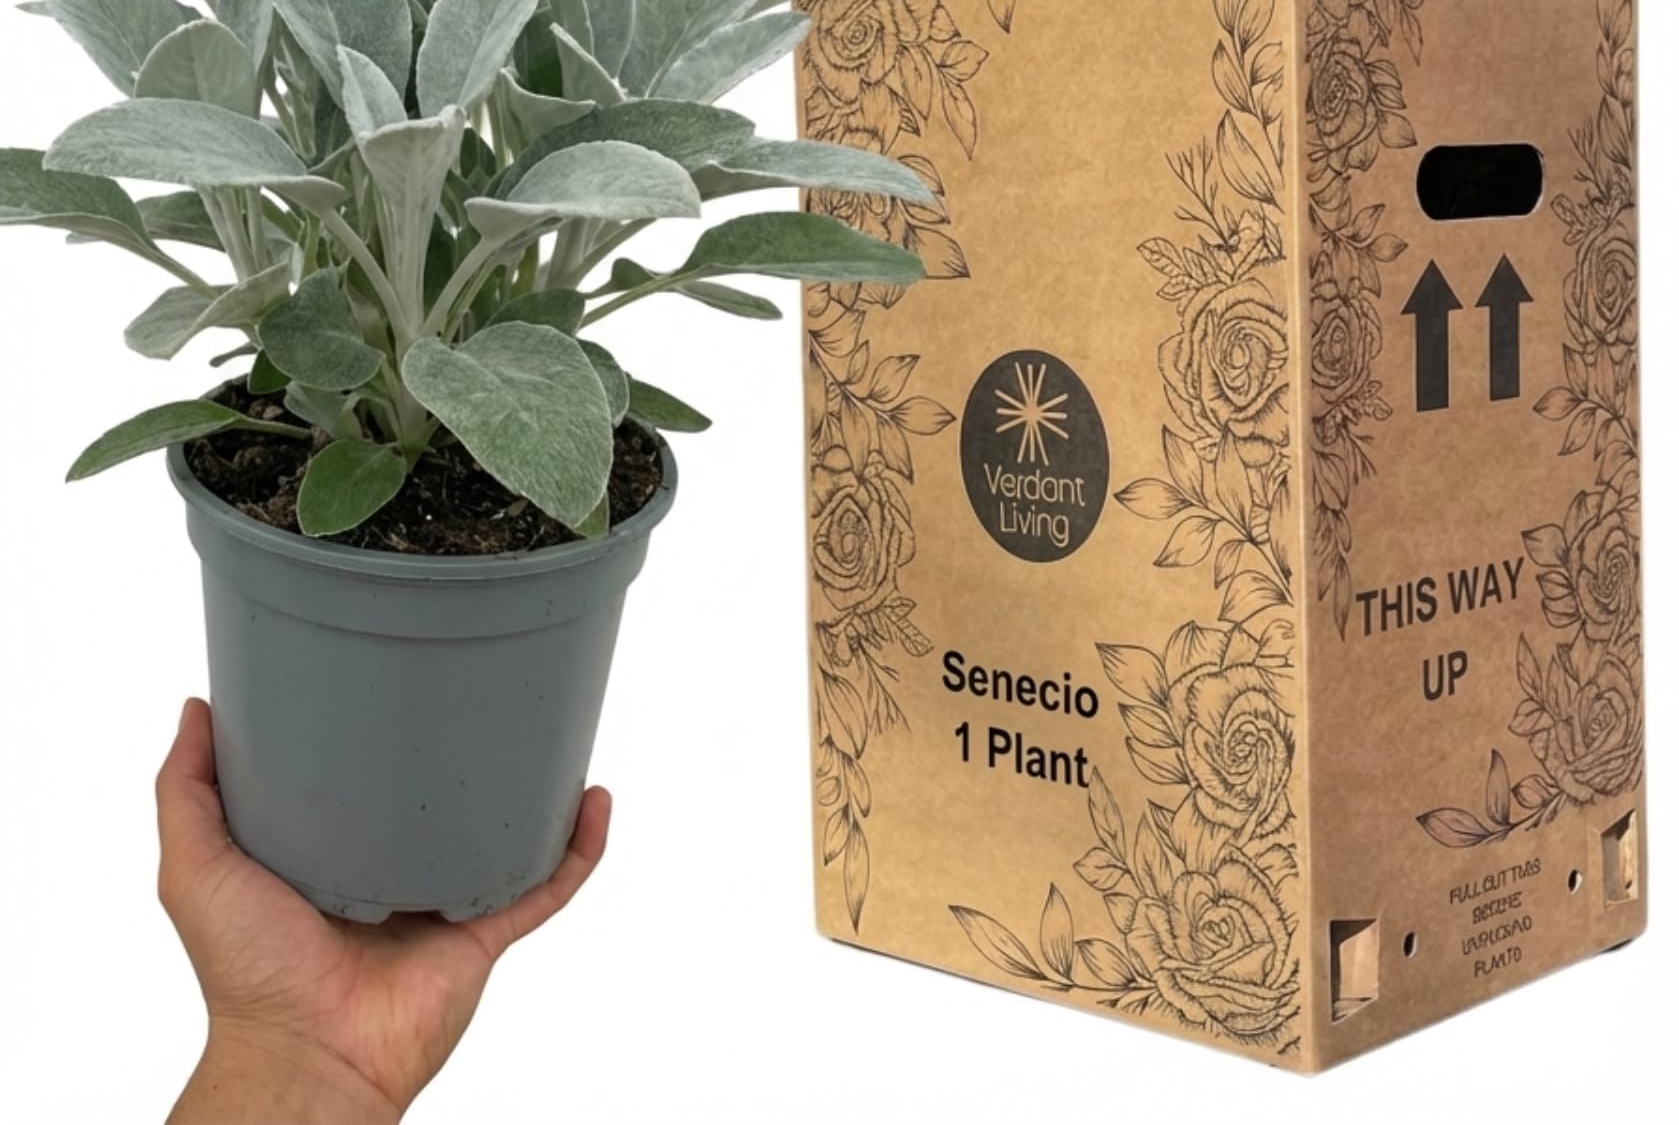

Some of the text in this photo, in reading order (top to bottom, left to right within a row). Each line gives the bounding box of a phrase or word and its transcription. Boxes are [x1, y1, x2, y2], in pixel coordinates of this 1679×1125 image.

[984, 463, 1085, 507] Verdant
[1000, 501, 1070, 547] Living
[1356, 556, 1524, 636] THIS WAY
[942, 650, 1099, 718] Senecio
[1423, 650, 1468, 701] UP
[955, 721, 1090, 788] 1 Plant
